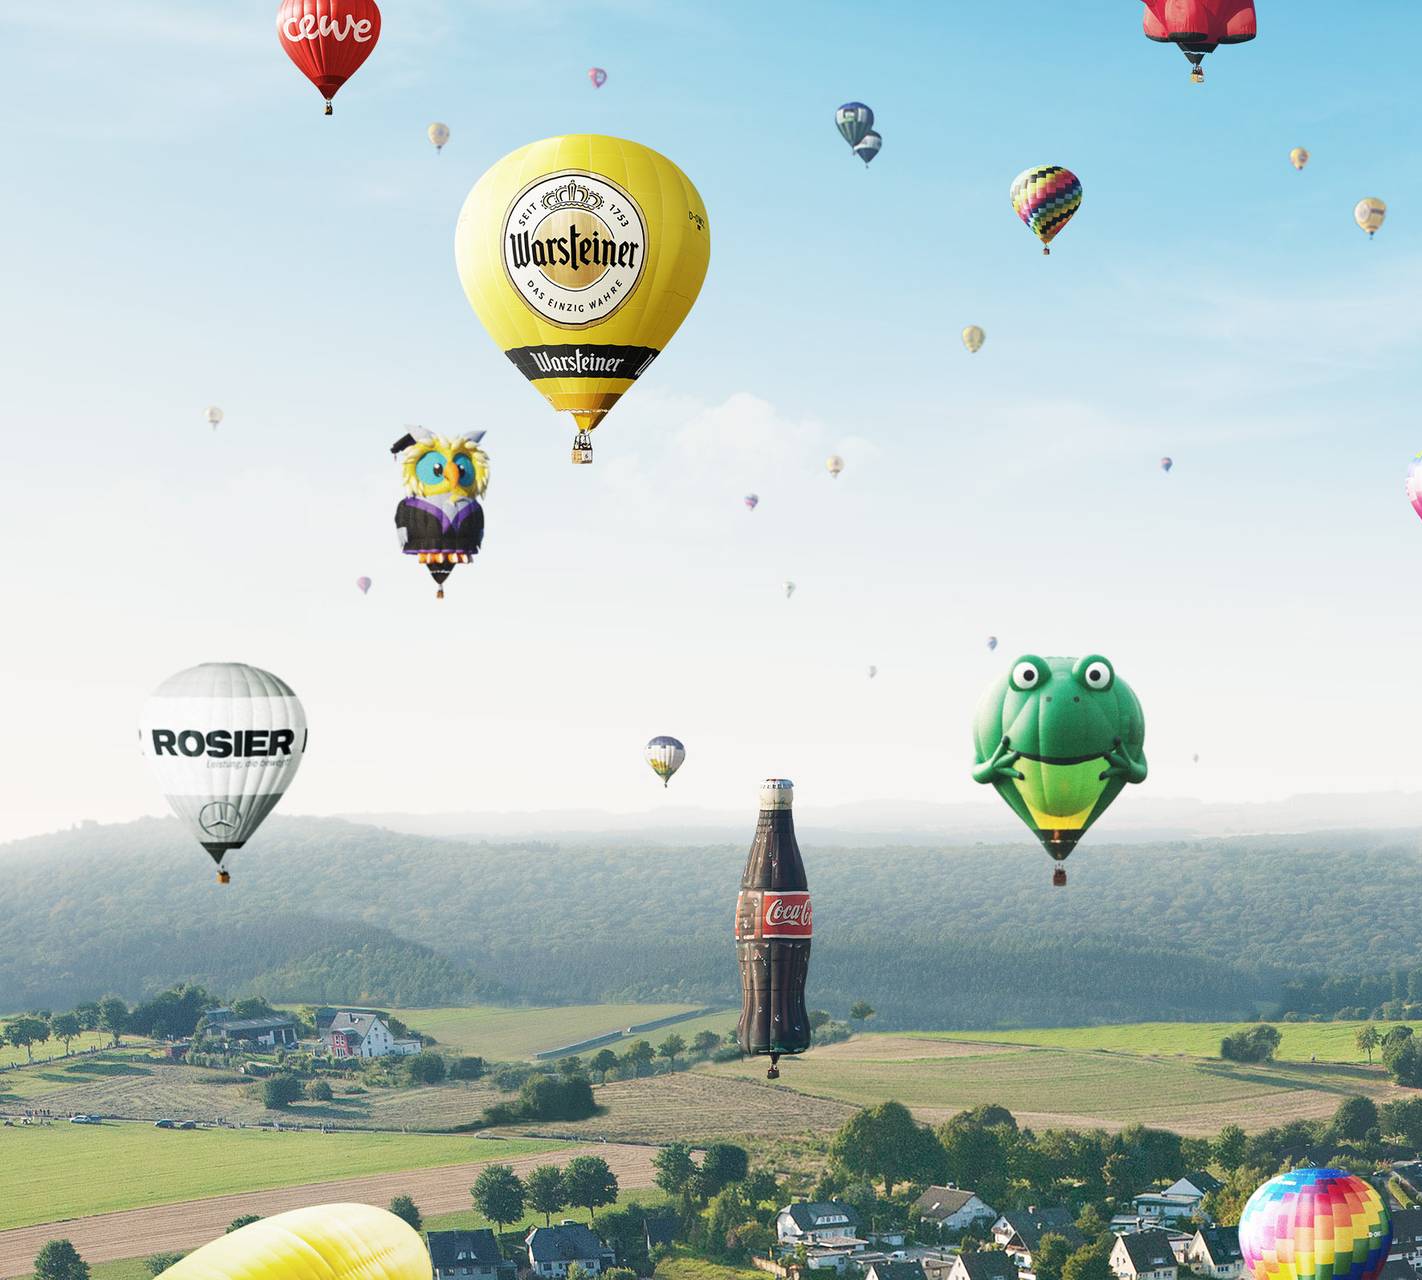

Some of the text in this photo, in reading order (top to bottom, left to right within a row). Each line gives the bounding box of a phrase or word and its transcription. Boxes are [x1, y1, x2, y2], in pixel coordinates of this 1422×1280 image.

[283, 14, 372, 42] cewe
[519, 203, 629, 228] SEIT 1753
[510, 224, 639, 271] Warsteiner
[527, 279, 622, 313] DAS EINZIG WAHRE
[530, 349, 624, 373] Warsteiner
[152, 729, 294, 758] ROSIER
